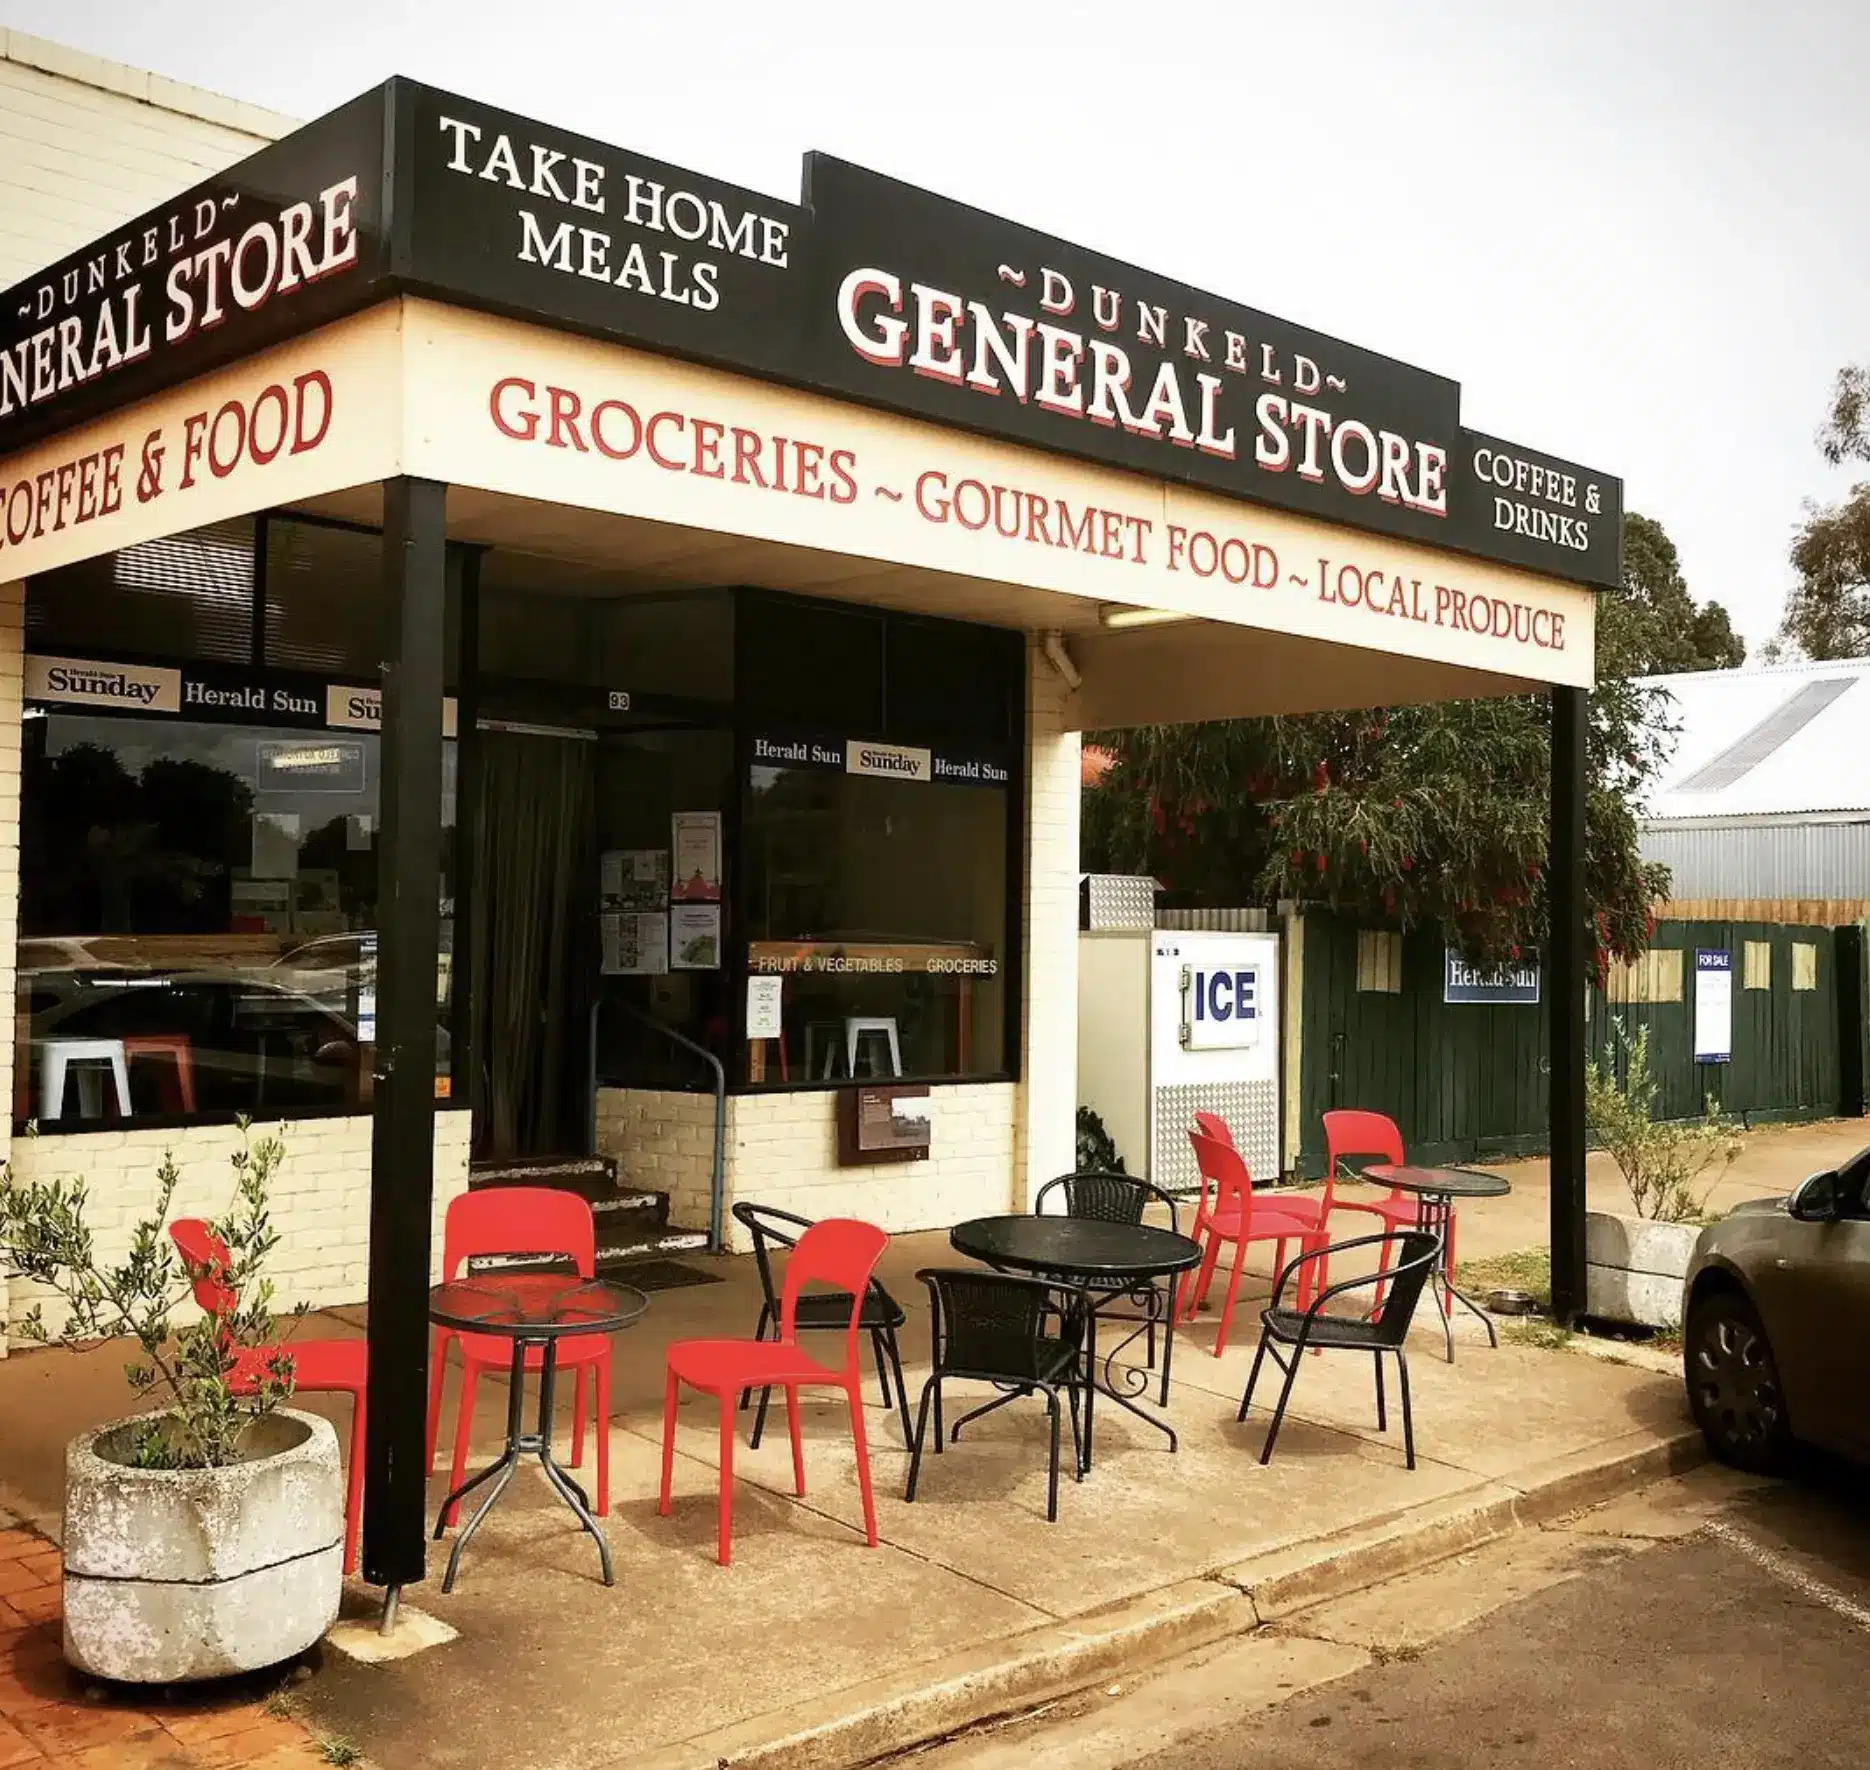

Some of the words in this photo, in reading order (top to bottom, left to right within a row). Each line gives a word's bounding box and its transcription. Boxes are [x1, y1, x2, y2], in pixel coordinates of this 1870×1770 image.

[439, 115, 606, 214] TAKE
[623, 174, 790, 269] HOME
[166, 175, 358, 346] STORE
[517, 210, 721, 312] MEALS
[837, 267, 1236, 460] GENERAL
[1255, 392, 1449, 518] STORE
[0, 443, 125, 549] OFFEE
[136, 428, 166, 503] &
[179, 369, 333, 490] FOOD
[1473, 448, 1577, 509] COFFEE
[1584, 482, 1602, 515] &
[490, 377, 858, 505] GROCERIES
[915, 471, 1152, 565] GOURMET
[1167, 524, 1279, 590] FOOD
[1317, 558, 1428, 625] LOCAL
[1434, 585, 1566, 652] PRODUCE
[1494, 498, 1588, 552] DRINKS
[48, 667, 161, 705] Sunday
[185, 682, 265, 711] Herald
[273, 690, 318, 715] Sun
[754, 739, 807, 762] Herald
[812, 744, 841, 765] Sun
[860, 750, 921, 776] Sunday
[934, 757, 979, 778] Herald
[982, 760, 1008, 781] Sun
[758, 956, 799, 973] FRUIT
[803, 956, 814, 973] &
[818, 957, 903, 973] VEGETABLES
[926, 958, 998, 975] GROCERIES
[1449, 960, 1504, 987] Herd
[1699, 954, 1713, 967] FOR
[1195, 970, 1256, 1022] ICE
